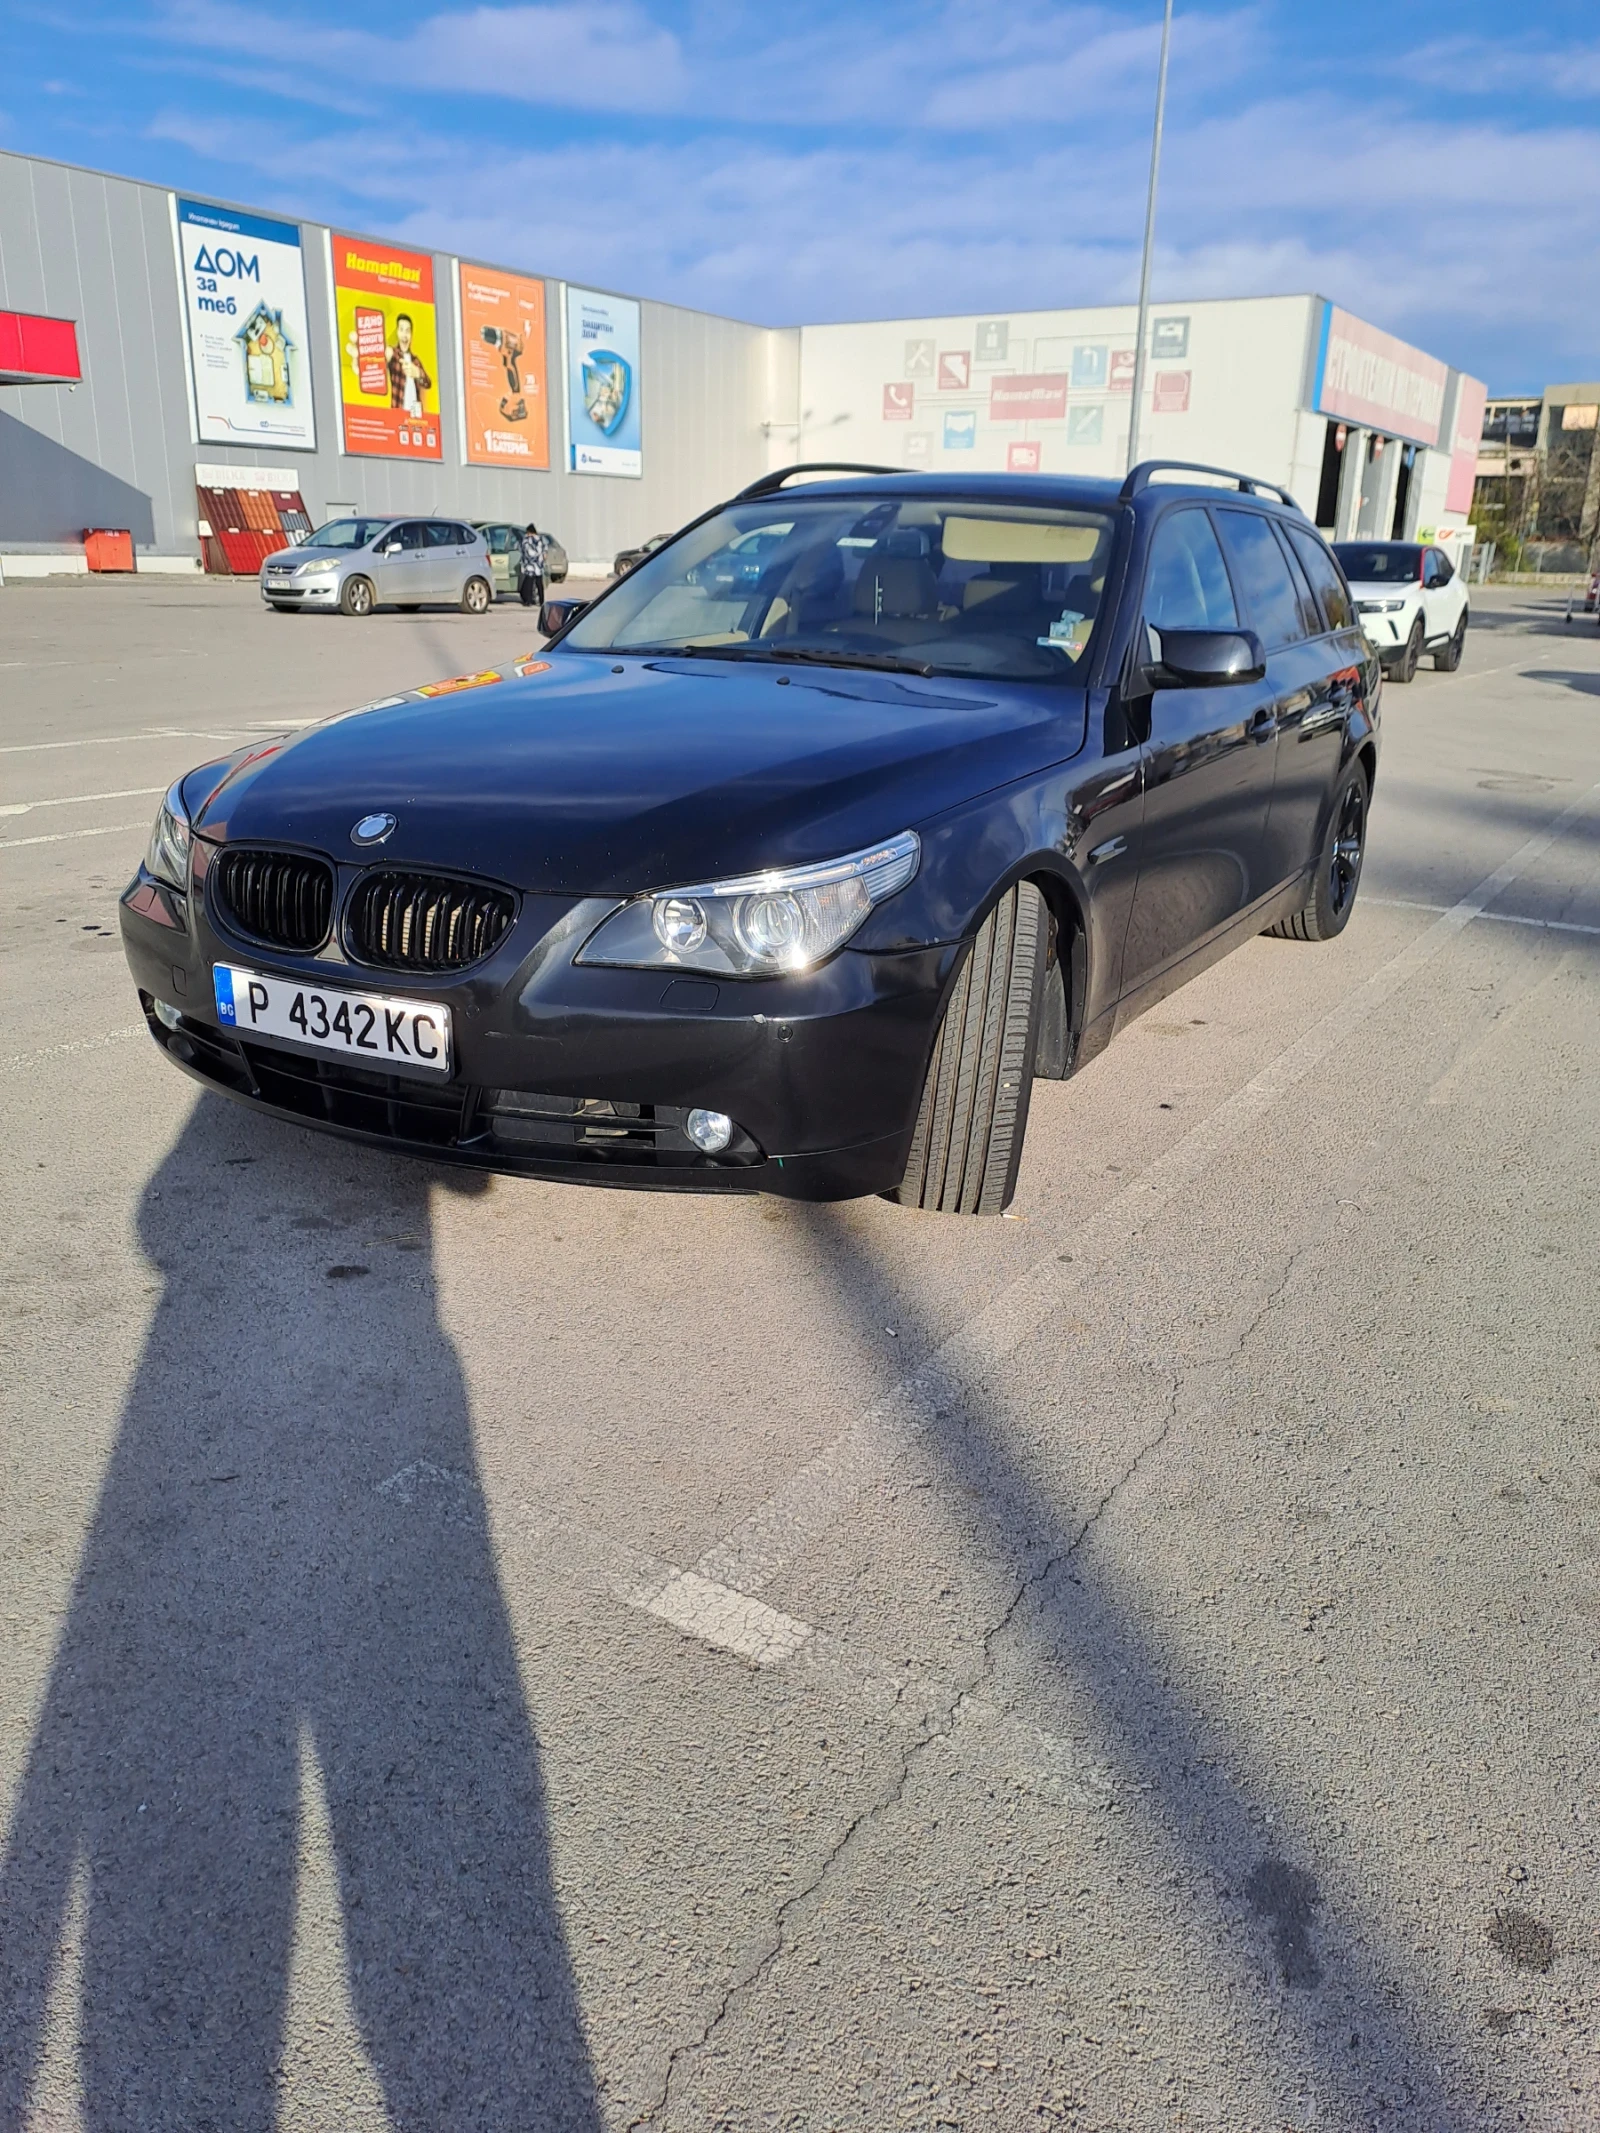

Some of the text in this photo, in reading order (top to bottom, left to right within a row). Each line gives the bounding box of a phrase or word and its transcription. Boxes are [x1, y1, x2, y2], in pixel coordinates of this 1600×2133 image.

[194, 243, 260, 283] ДОМ
[346, 252, 421, 283] HomeMax
[196, 276, 217, 293] за
[197, 296, 237, 315] теб
[357, 314, 383, 330] ЕДНО
[219, 1001, 235, 1017] BG
